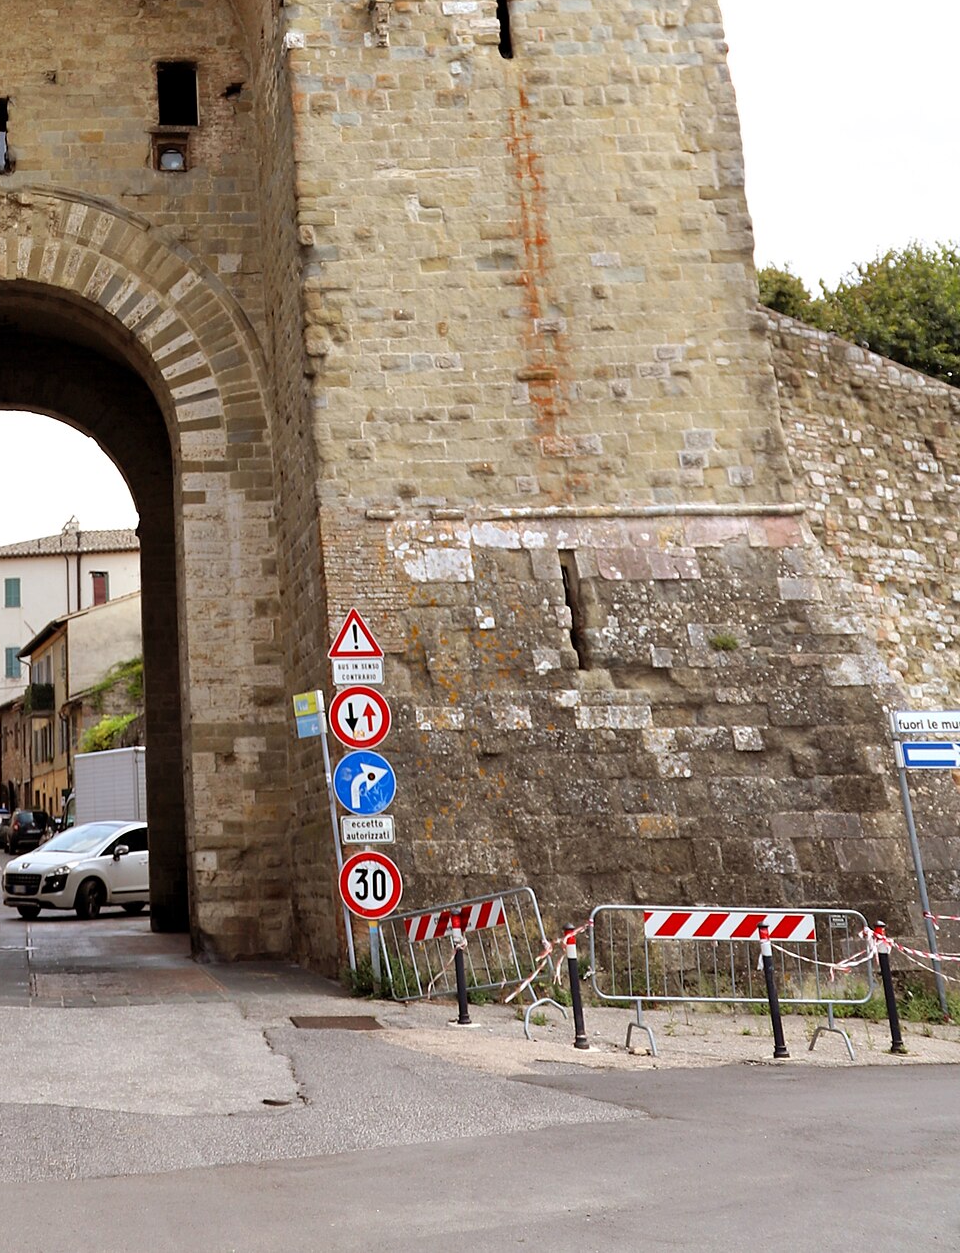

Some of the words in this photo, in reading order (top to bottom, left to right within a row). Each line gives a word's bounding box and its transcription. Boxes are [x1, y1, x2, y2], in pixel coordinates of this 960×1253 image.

[898, 719, 924, 730] fuori
[927, 719, 938, 730] le
[941, 721, 960, 729] mu
[351, 819, 384, 828] eccetto
[346, 831, 390, 840] autorizzati
[354, 868, 386, 901] 30
